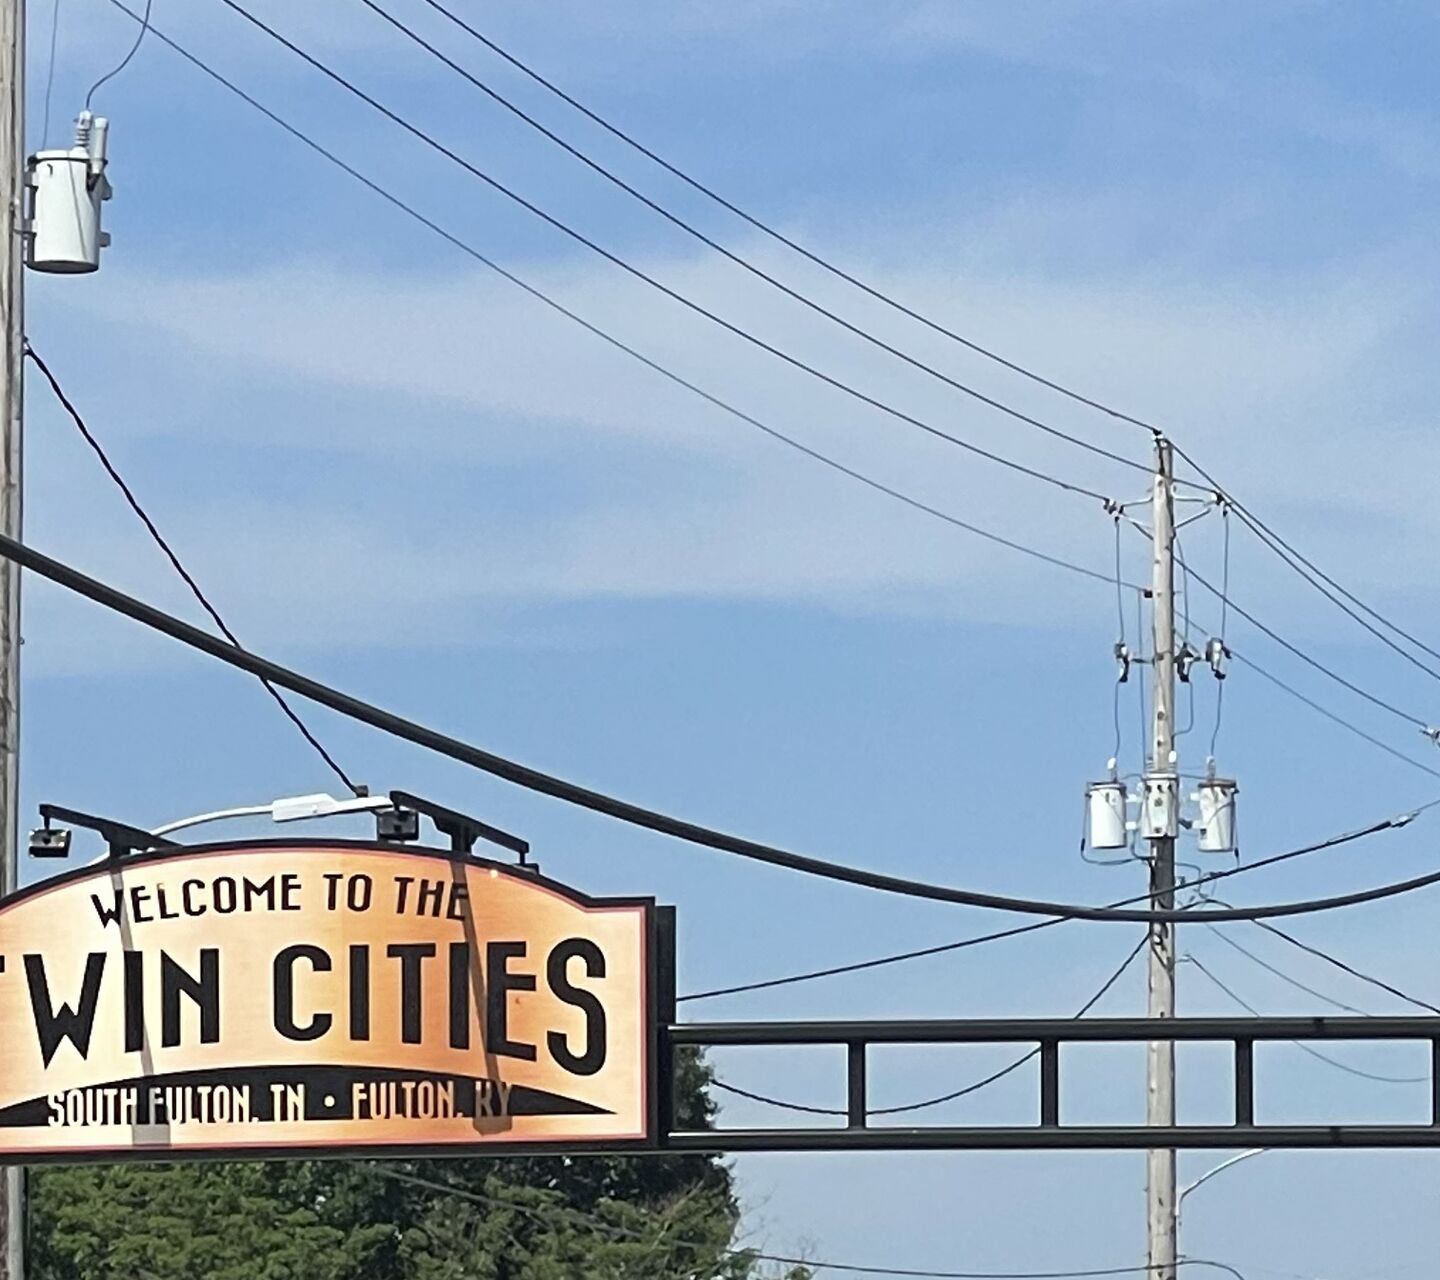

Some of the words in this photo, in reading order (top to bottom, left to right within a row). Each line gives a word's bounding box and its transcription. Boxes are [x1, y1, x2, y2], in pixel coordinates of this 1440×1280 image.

[90, 874, 302, 928] WELCOME
[323, 874, 372, 912] TO
[394, 876, 467, 921] THE
[272, 937, 607, 1076] CITIES
[47, 1087, 138, 1126] SOUTH
[270, 1083, 306, 1121] TN
[474, 1080, 513, 1118] KY
